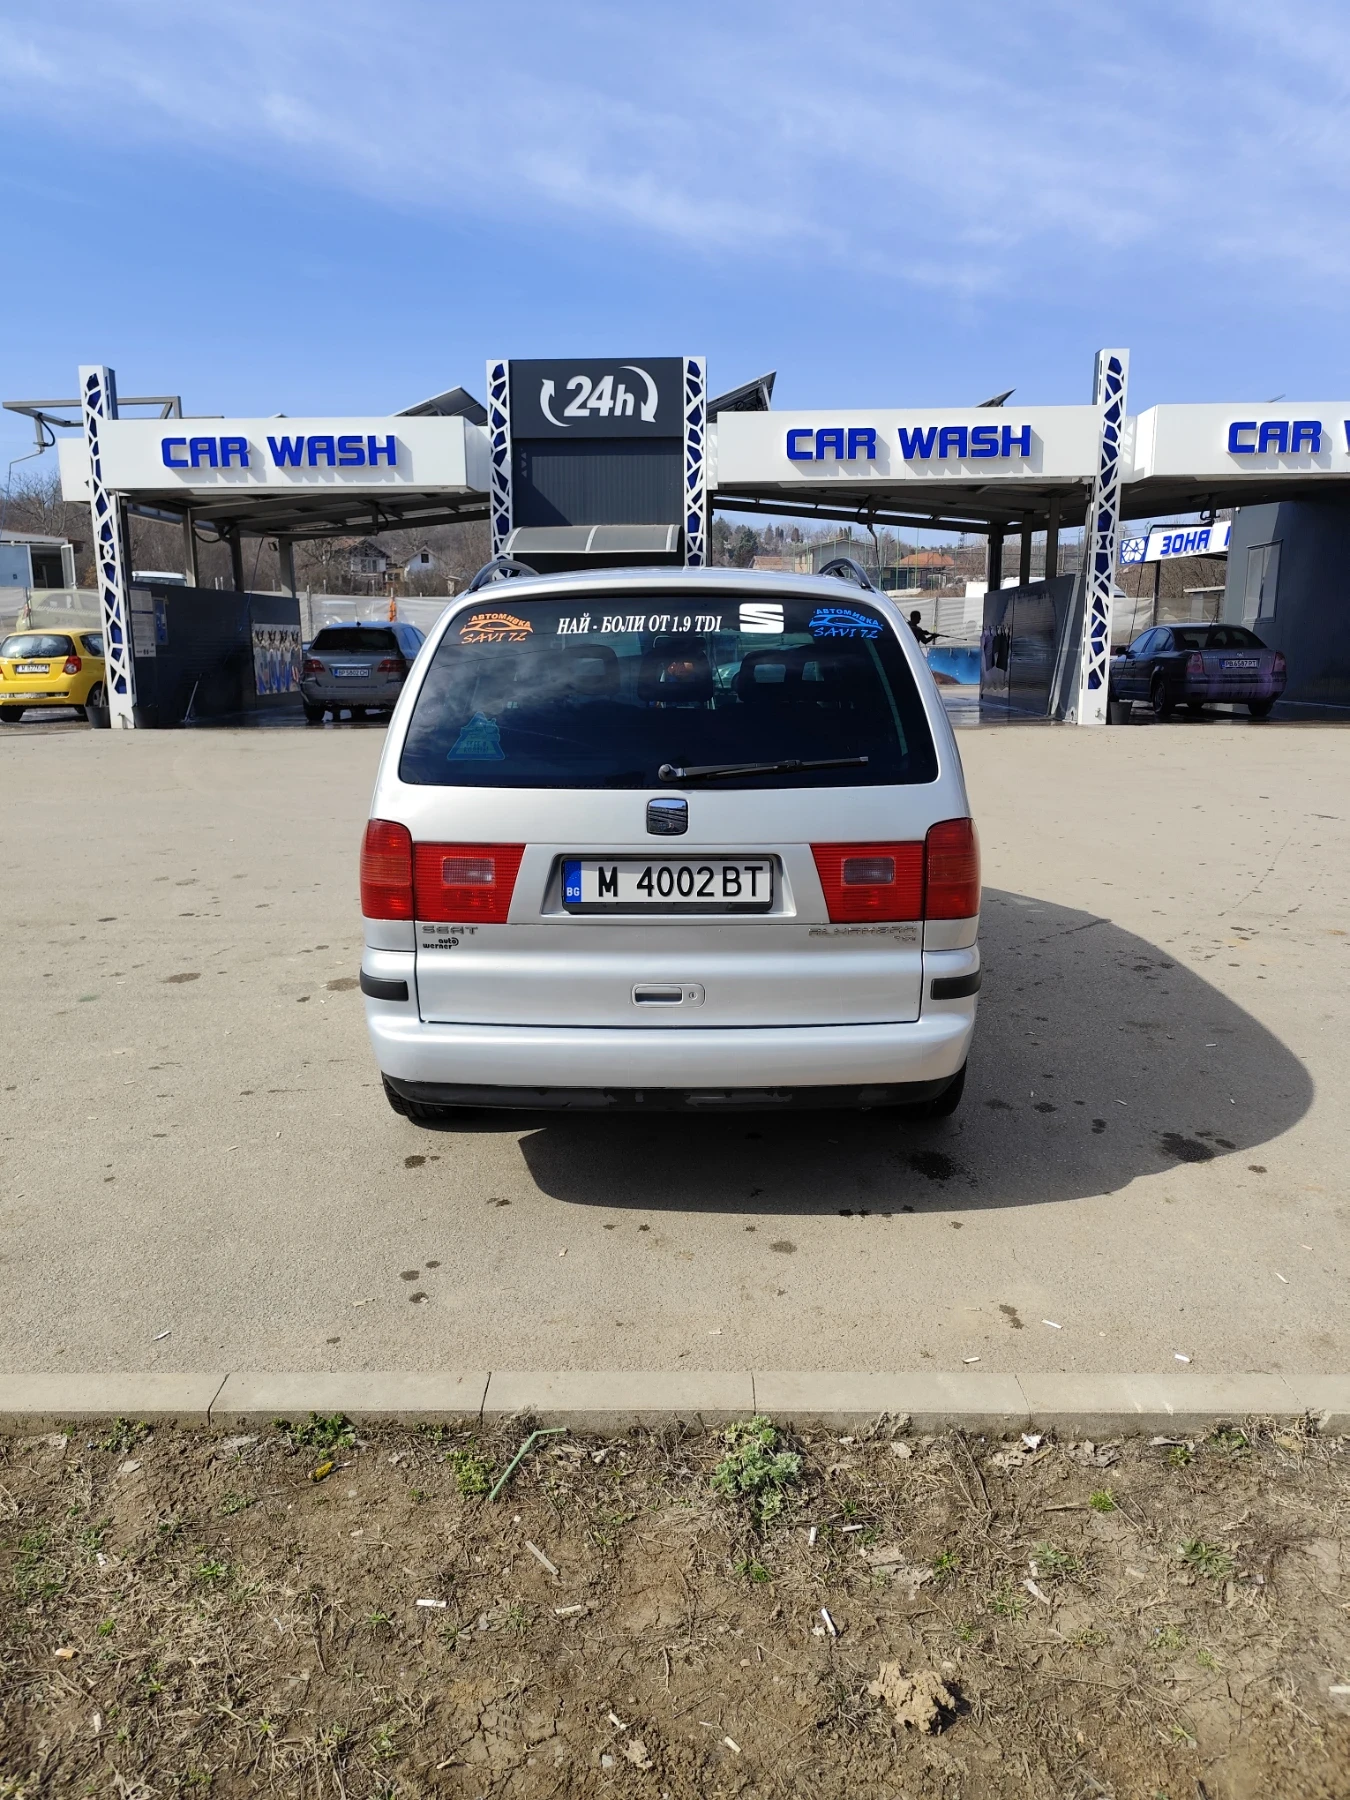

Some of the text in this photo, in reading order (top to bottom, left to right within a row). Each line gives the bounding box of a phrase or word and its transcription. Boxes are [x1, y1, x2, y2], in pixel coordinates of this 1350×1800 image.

[563, 375, 635, 417] 24h
[787, 425, 1031, 461] CAR WASH
[1228, 420, 1322, 453] CAR
[161, 435, 398, 468] CAR WASH
[1160, 529, 1211, 555] ЗОНА
[471, 613, 531, 628] АВТОМИВКА
[556, 613, 591, 635] НАЙ
[601, 615, 646, 633] БОЛИ
[648, 614, 670, 632] ОТ
[672, 615, 692, 632] 1.9
[694, 616, 722, 633] TDI
[816, 608, 879, 626] АВТОМИВКА
[461, 632, 506, 644] SAVI
[814, 627, 856, 637] SAVI
[566, 887, 580, 897] BG
[598, 866, 618, 897] M
[422, 925, 478, 935] SEAT
